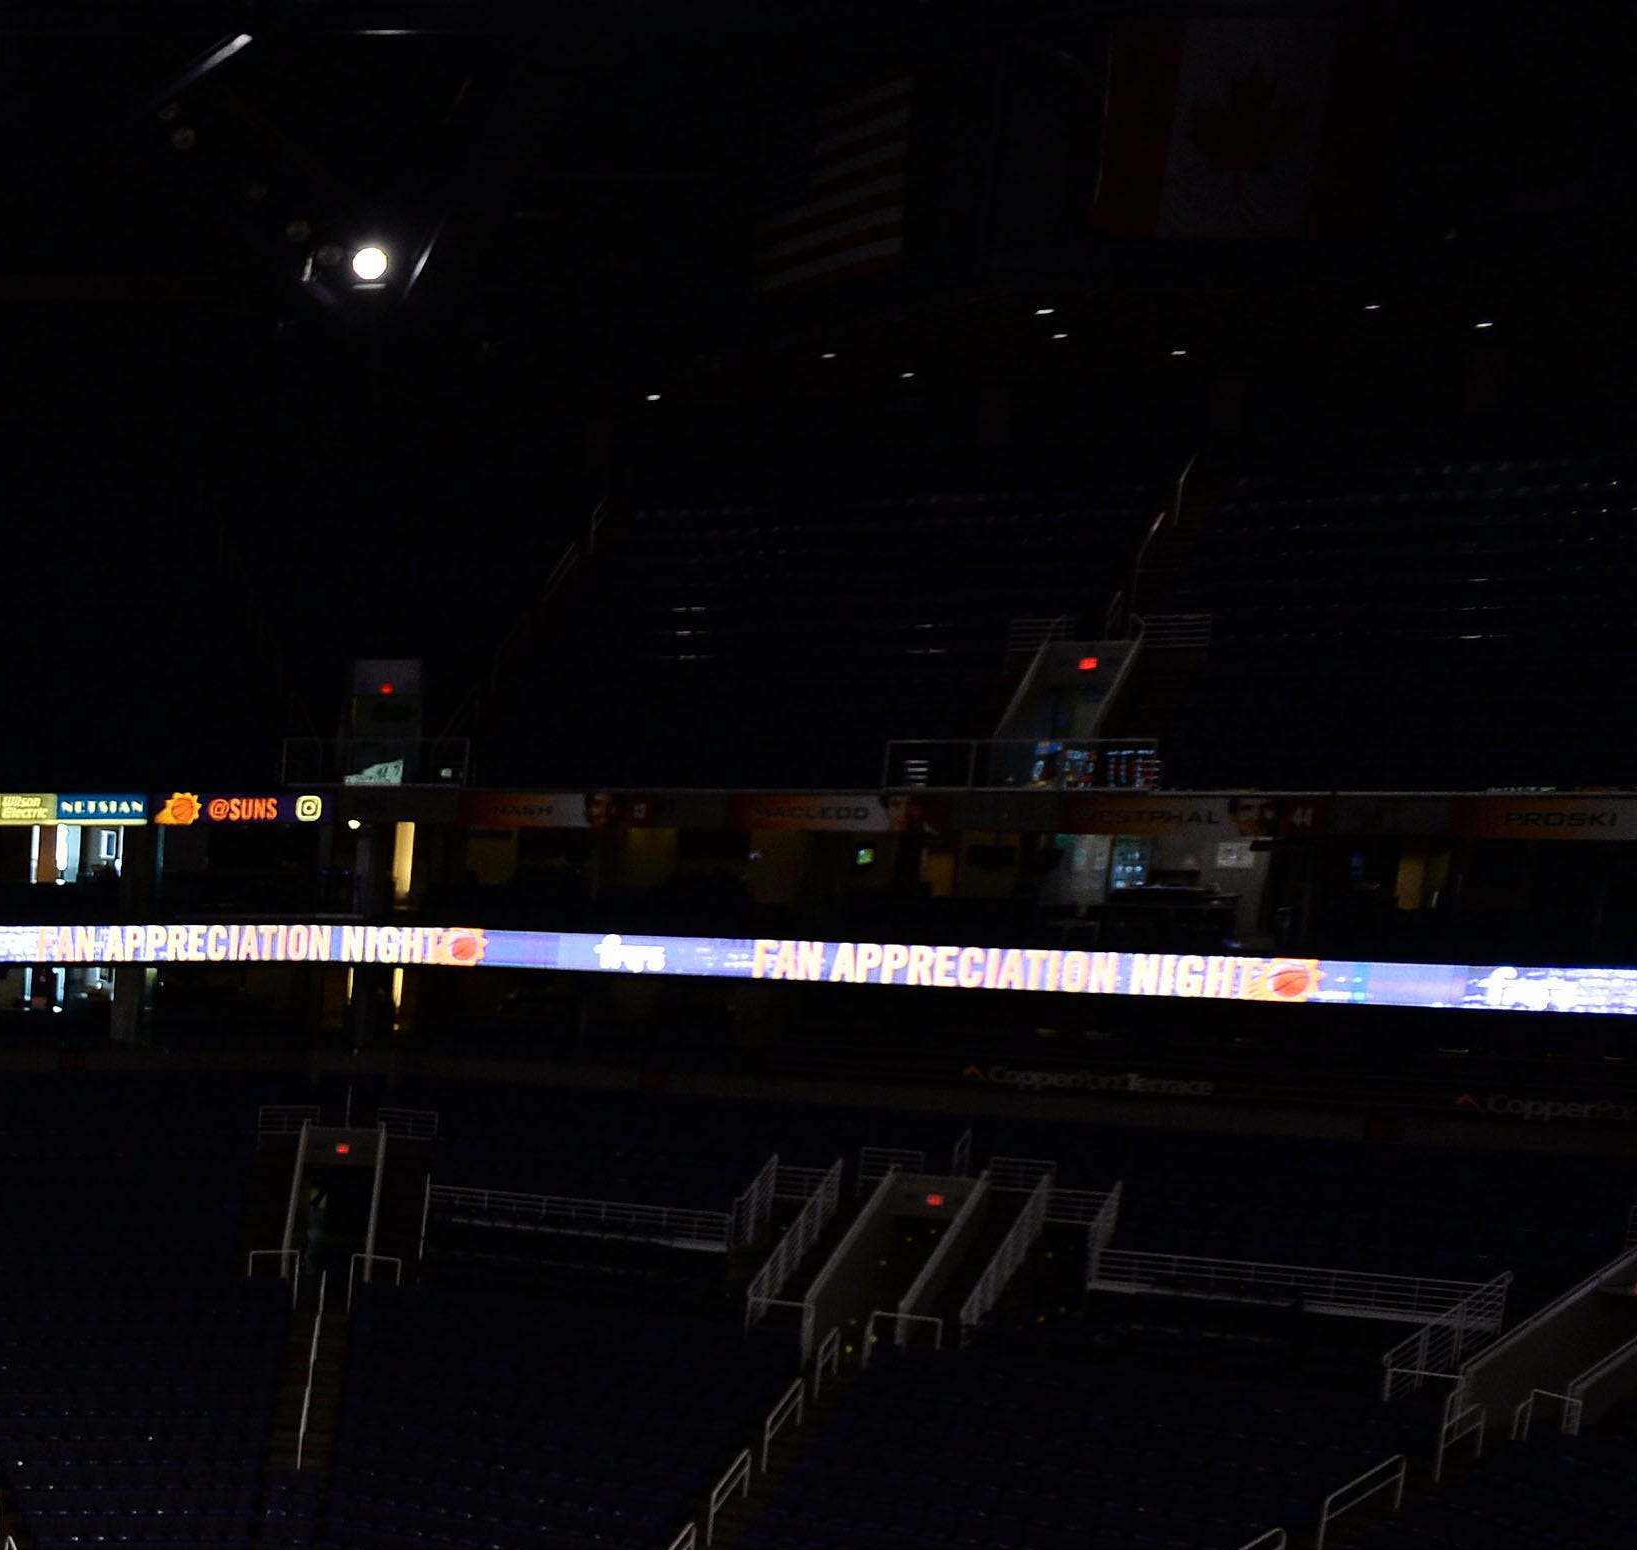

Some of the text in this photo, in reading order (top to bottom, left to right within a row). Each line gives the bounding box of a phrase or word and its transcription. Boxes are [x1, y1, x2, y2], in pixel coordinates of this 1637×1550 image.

[2, 797, 42, 808] Wilson
[208, 799, 278, 820] @SUNS
[2, 808, 48, 819] Electric
[1503, 811, 1618, 828] PROSKI
[38, 925, 442, 964] FAN APPRECIATION NIGHT
[754, 940, 823, 982] FAN
[832, 943, 1118, 993] APPRECIATION
[1130, 954, 1260, 999] NIGHT
